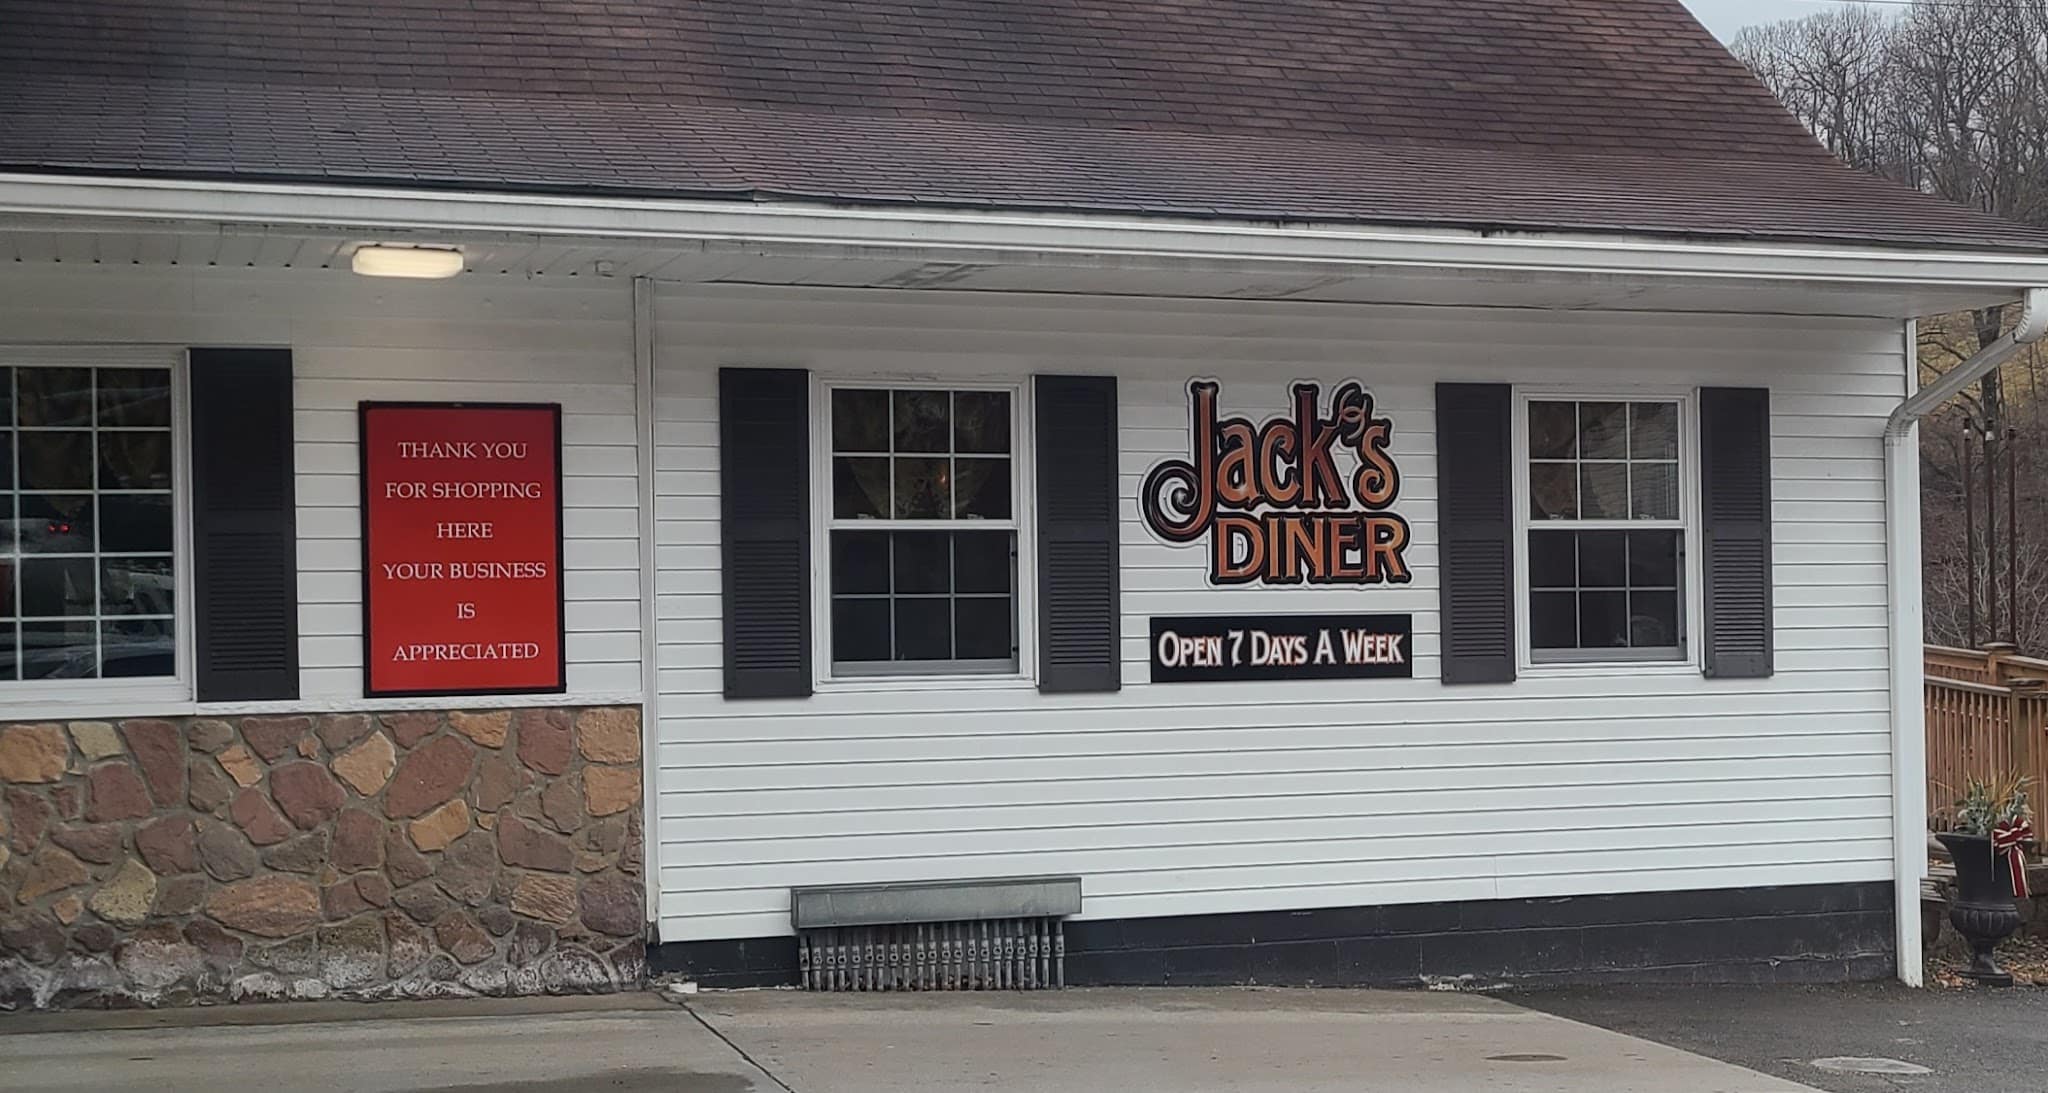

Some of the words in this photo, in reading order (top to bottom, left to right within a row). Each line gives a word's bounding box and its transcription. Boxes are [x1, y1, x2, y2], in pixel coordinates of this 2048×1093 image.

[398, 442, 477, 458] THANK
[482, 442, 528, 458] YOU
[1144, 380, 1400, 542] Jack's
[386, 482, 428, 498] FOR
[432, 482, 541, 498] SHOPPING
[437, 522, 493, 538] HERE
[1211, 513, 1411, 582] DINER
[383, 563, 444, 579] YOUR
[449, 562, 547, 579] BUSINESS
[457, 603, 476, 619] IS
[392, 642, 540, 661] APPRECIATED
[1228, 629, 1244, 667] 7
[1313, 629, 1337, 665] A
